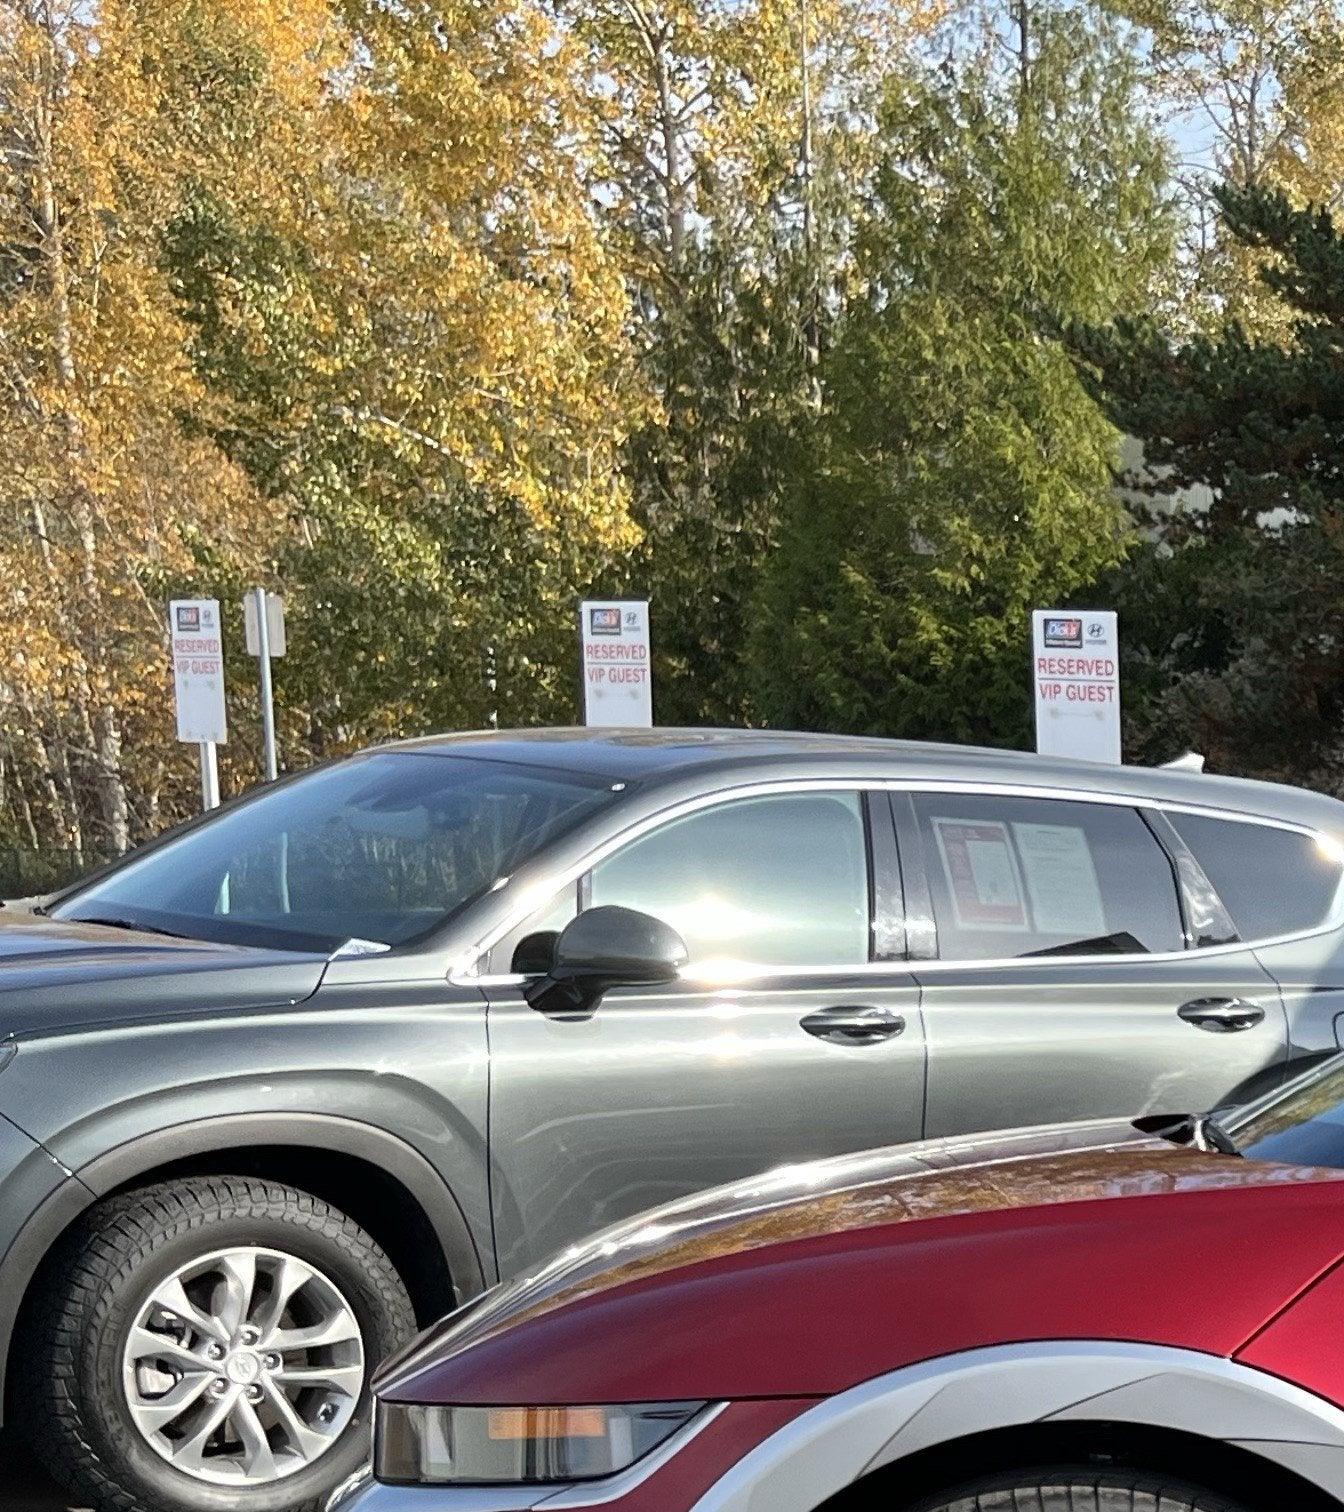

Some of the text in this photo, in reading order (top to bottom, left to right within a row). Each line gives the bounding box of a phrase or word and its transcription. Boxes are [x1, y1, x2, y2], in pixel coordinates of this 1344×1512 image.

[586, 645, 647, 660] RESERVED
[1038, 658, 1114, 676] RESERVED
[588, 668, 647, 683] VIP GUEST
[1040, 684, 1114, 702] VIP GUEST
